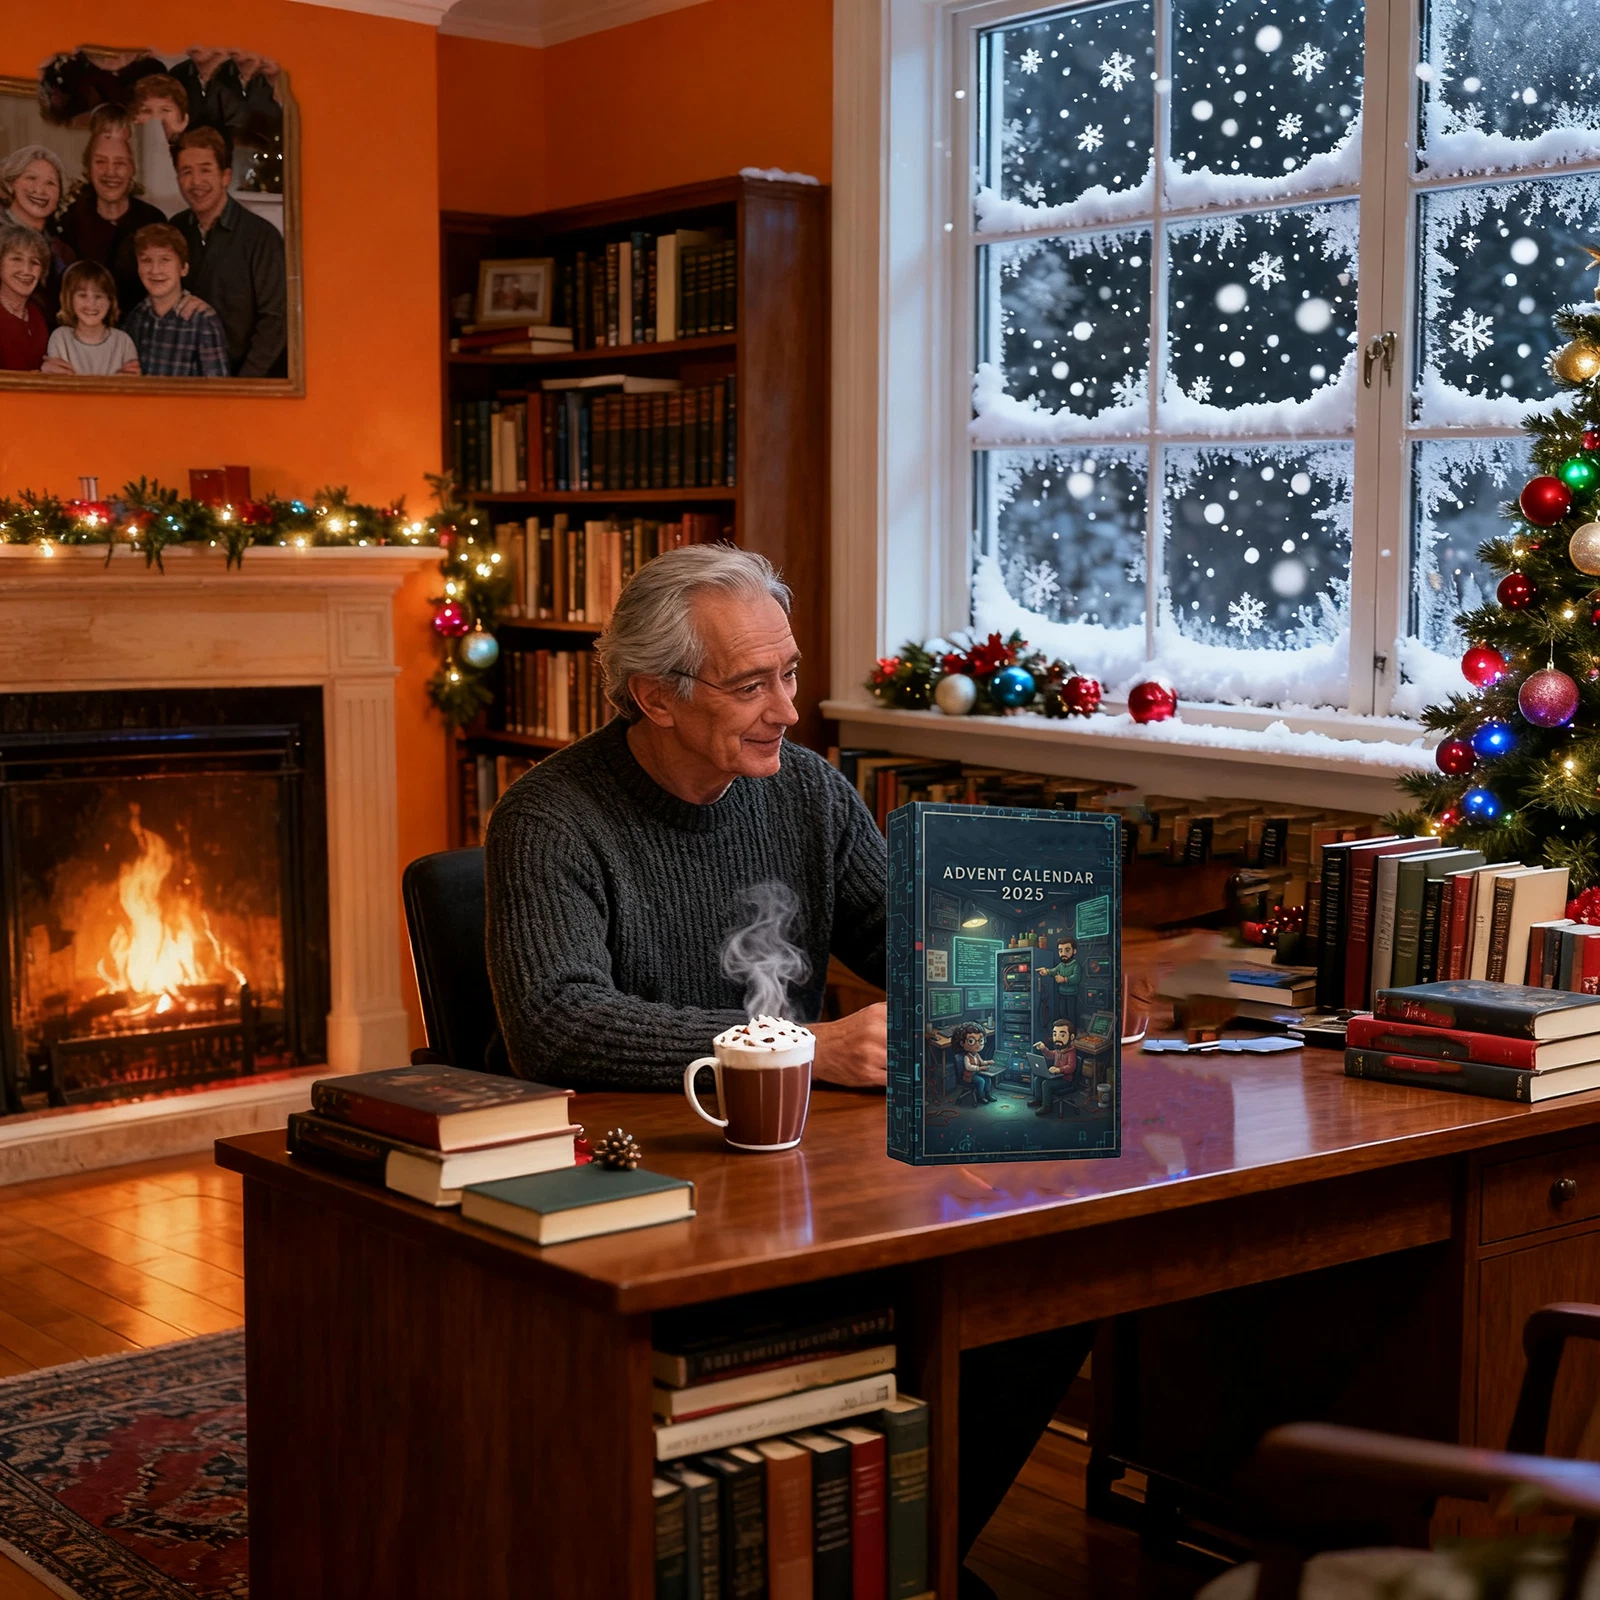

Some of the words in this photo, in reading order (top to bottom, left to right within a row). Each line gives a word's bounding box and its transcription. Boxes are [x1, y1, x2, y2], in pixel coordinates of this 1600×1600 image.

[943, 866, 1007, 881] ADVENT
[1012, 868, 1094, 884] CALENDAR
[1002, 886, 1044, 901] 2025
